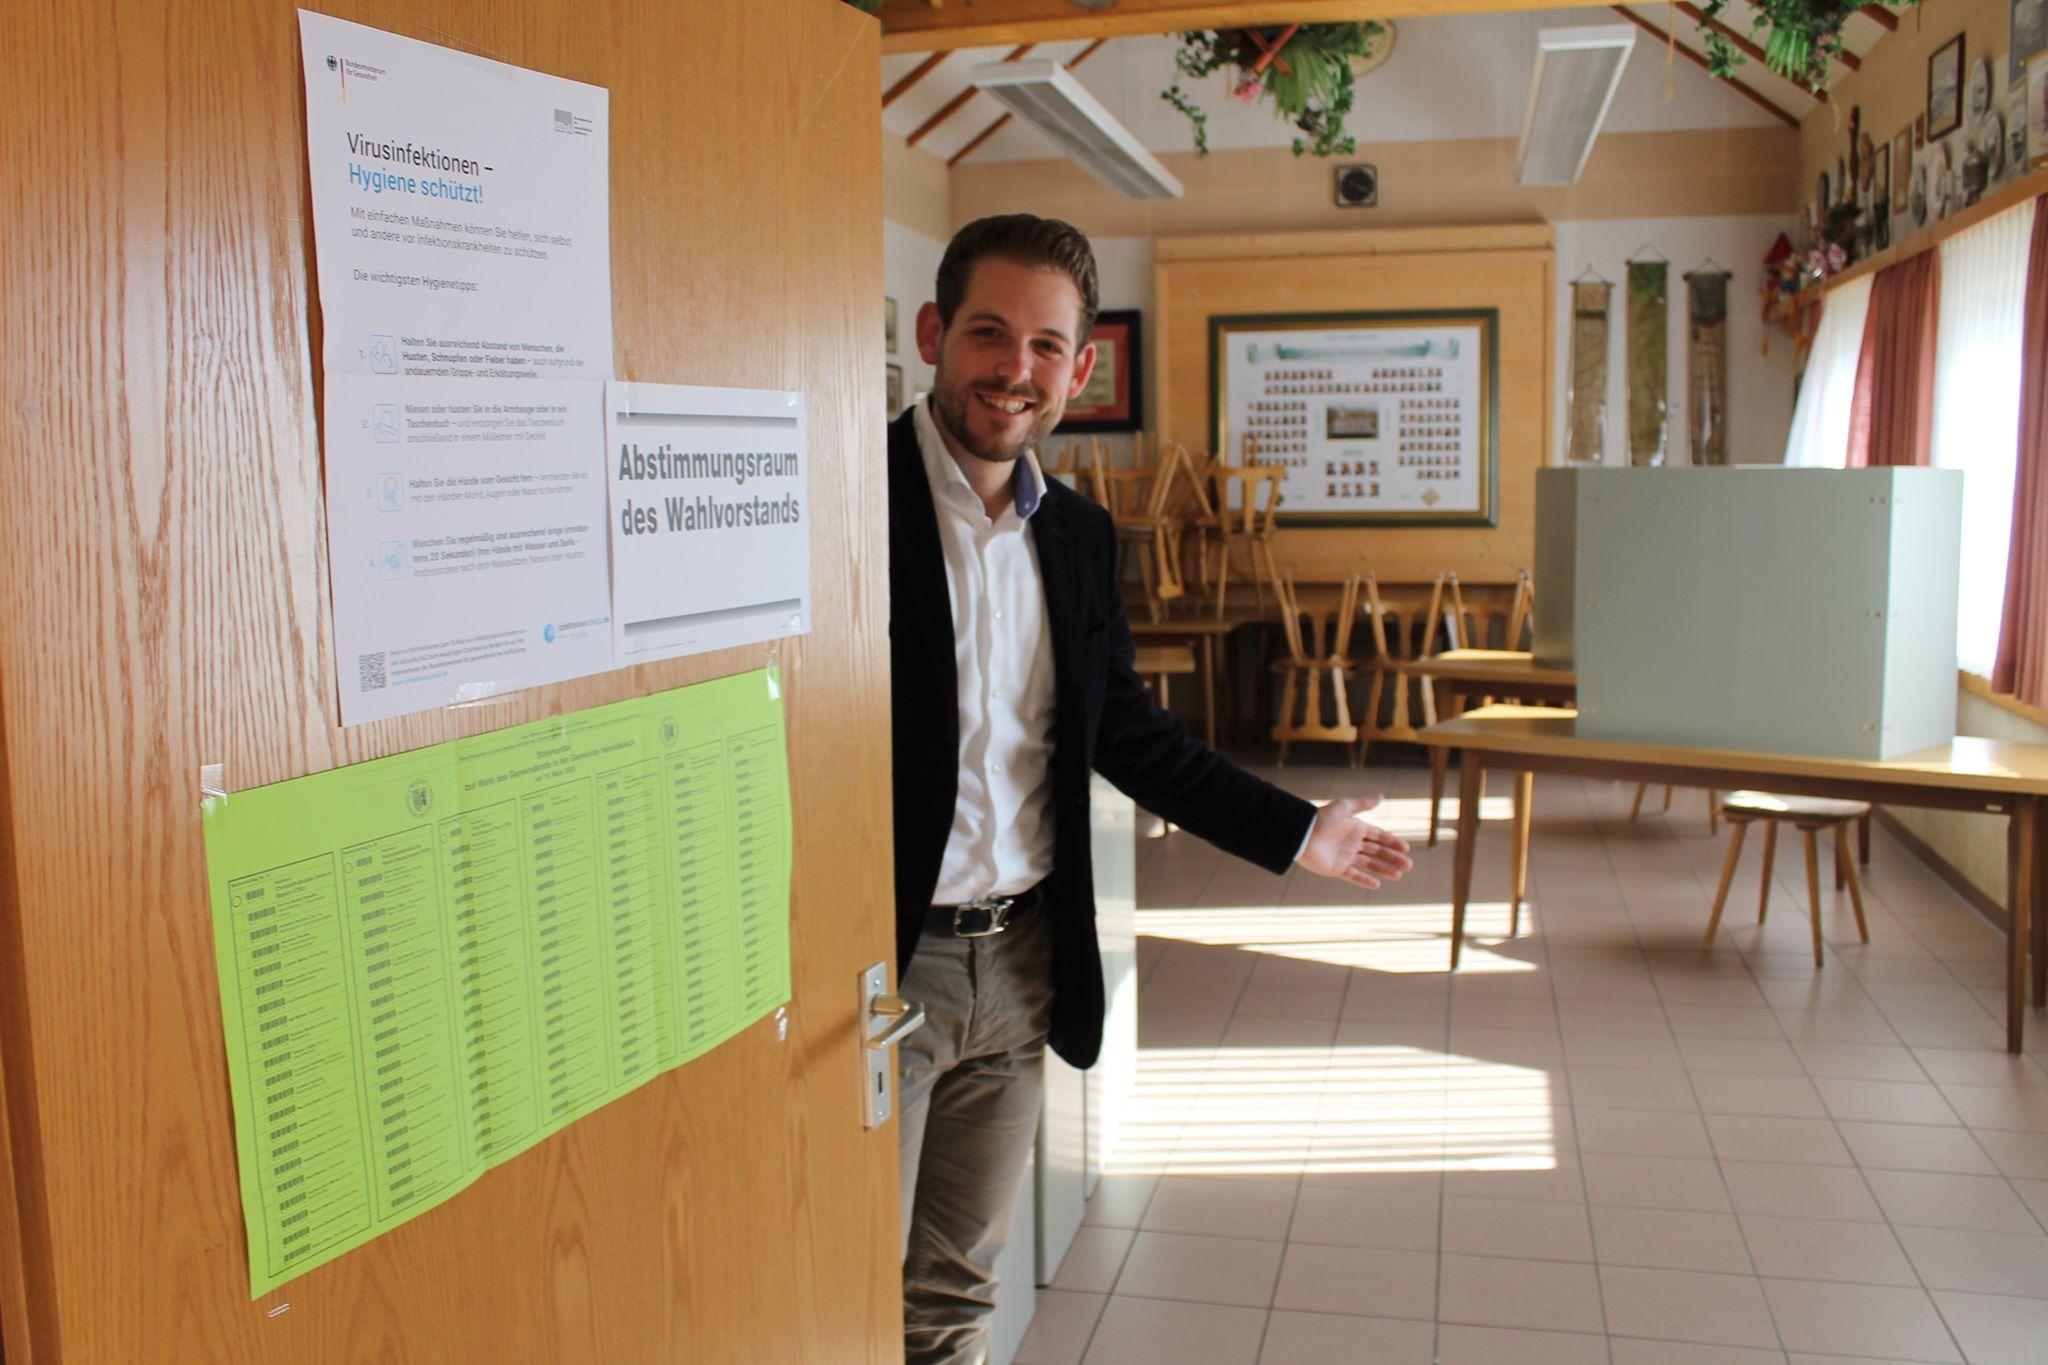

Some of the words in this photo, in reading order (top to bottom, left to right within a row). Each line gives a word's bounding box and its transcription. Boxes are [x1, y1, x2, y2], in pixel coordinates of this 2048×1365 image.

[346, 132, 480, 176] Virusinfektionen
[349, 163, 416, 194] Hygiene
[420, 178, 484, 204] schützt!
[350, 206, 365, 219] Mit
[368, 209, 410, 225] einfachen
[411, 215, 463, 232] Maßnahmen
[464, 222, 493, 236] können
[495, 226, 507, 238] Sie
[351, 226, 368, 239] und
[370, 229, 400, 242] andere
[402, 234, 416, 244] vor
[417, 234, 502, 253] Infektionskrankheiten
[353, 268, 368, 282] Die
[370, 271, 422, 288] wichtigsten
[401, 336, 425, 347] Halten
[426, 337, 438, 347] Sie
[431, 352, 468, 364] Schnupfen
[618, 443, 798, 485] Abstimmungsraum
[621, 498, 658, 536] des
[664, 492, 800, 533] Wahlvorstands
